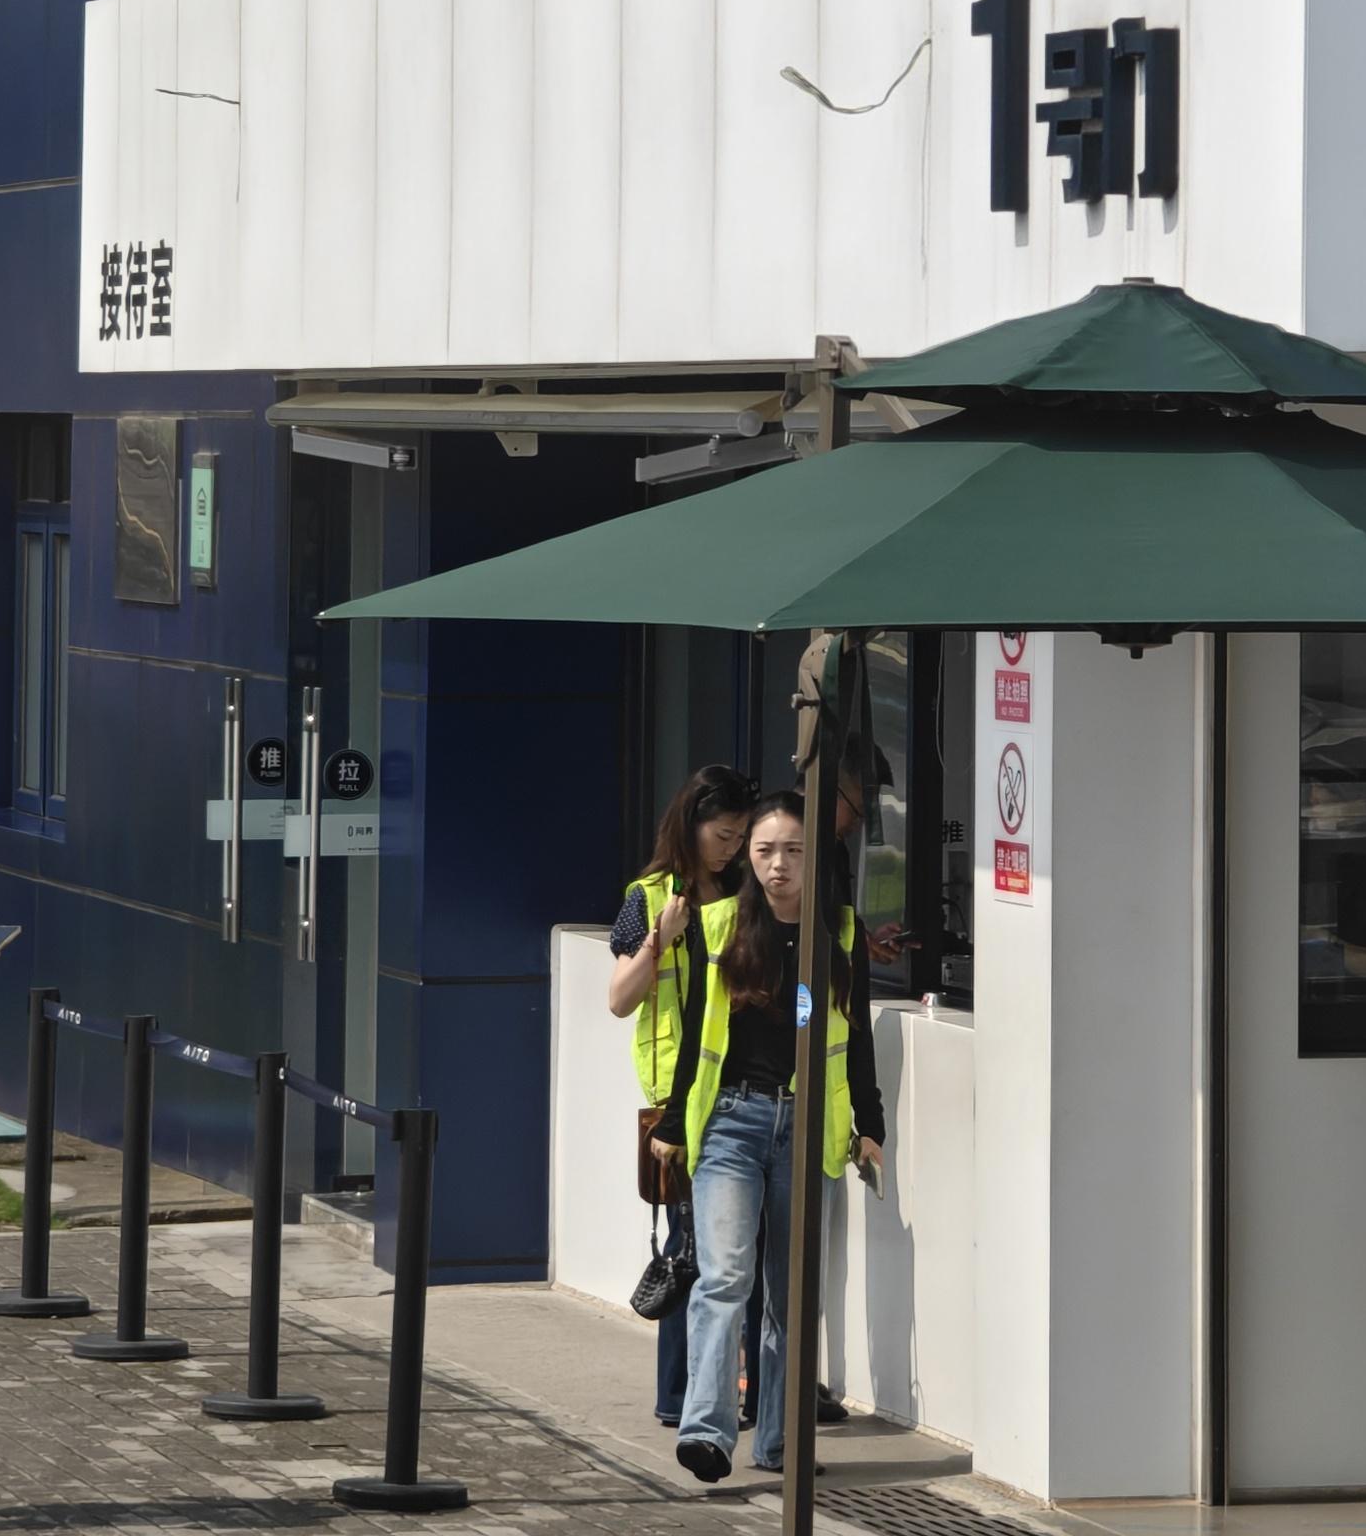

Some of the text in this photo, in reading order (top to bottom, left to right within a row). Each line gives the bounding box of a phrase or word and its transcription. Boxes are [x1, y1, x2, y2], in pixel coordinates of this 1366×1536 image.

[99, 239, 173, 341] 接待室
[260, 747, 281, 769] 推
[339, 759, 360, 781] 拉
[339, 783, 359, 791] PULL
[996, 848, 1028, 873] 禁止吸烟
